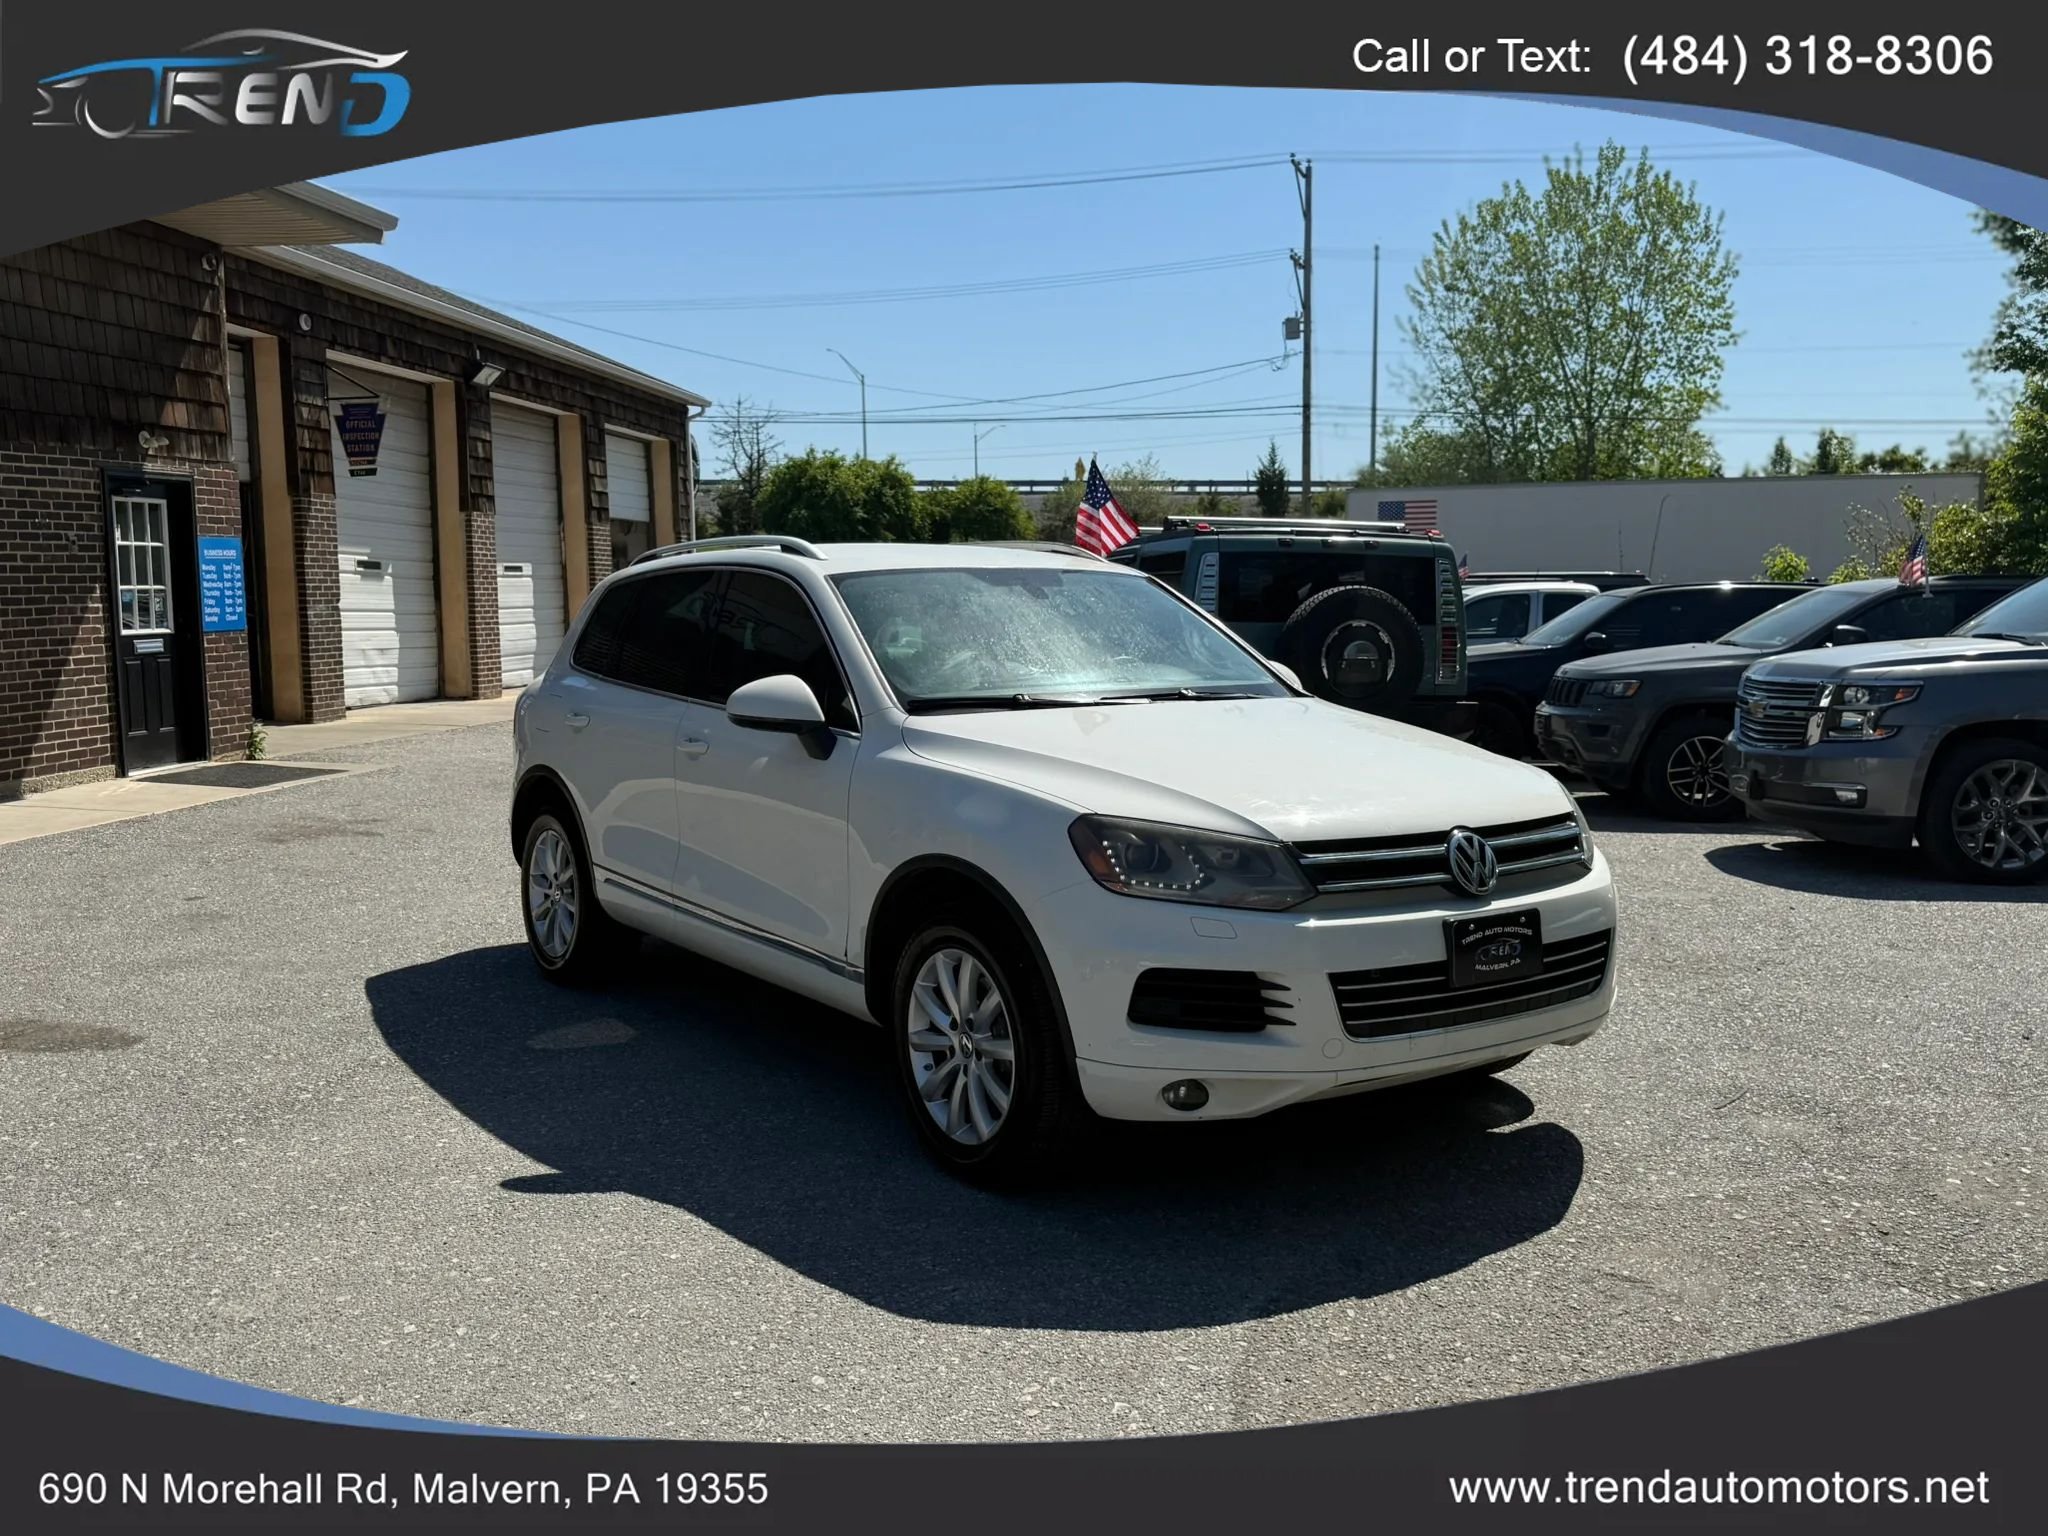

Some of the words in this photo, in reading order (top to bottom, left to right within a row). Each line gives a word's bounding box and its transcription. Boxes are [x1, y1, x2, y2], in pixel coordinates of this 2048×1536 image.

[346, 420, 376, 429] OFFICIAL
[342, 432, 380, 440] INSPECTION
[347, 444, 376, 452] STATION
[203, 549, 223, 557] BUSINESS
[223, 549, 237, 557] HOURS
[1461, 931, 1484, 945] TREND
[1484, 926, 1503, 936] AUTO
[1503, 926, 1533, 936] MOTORS
